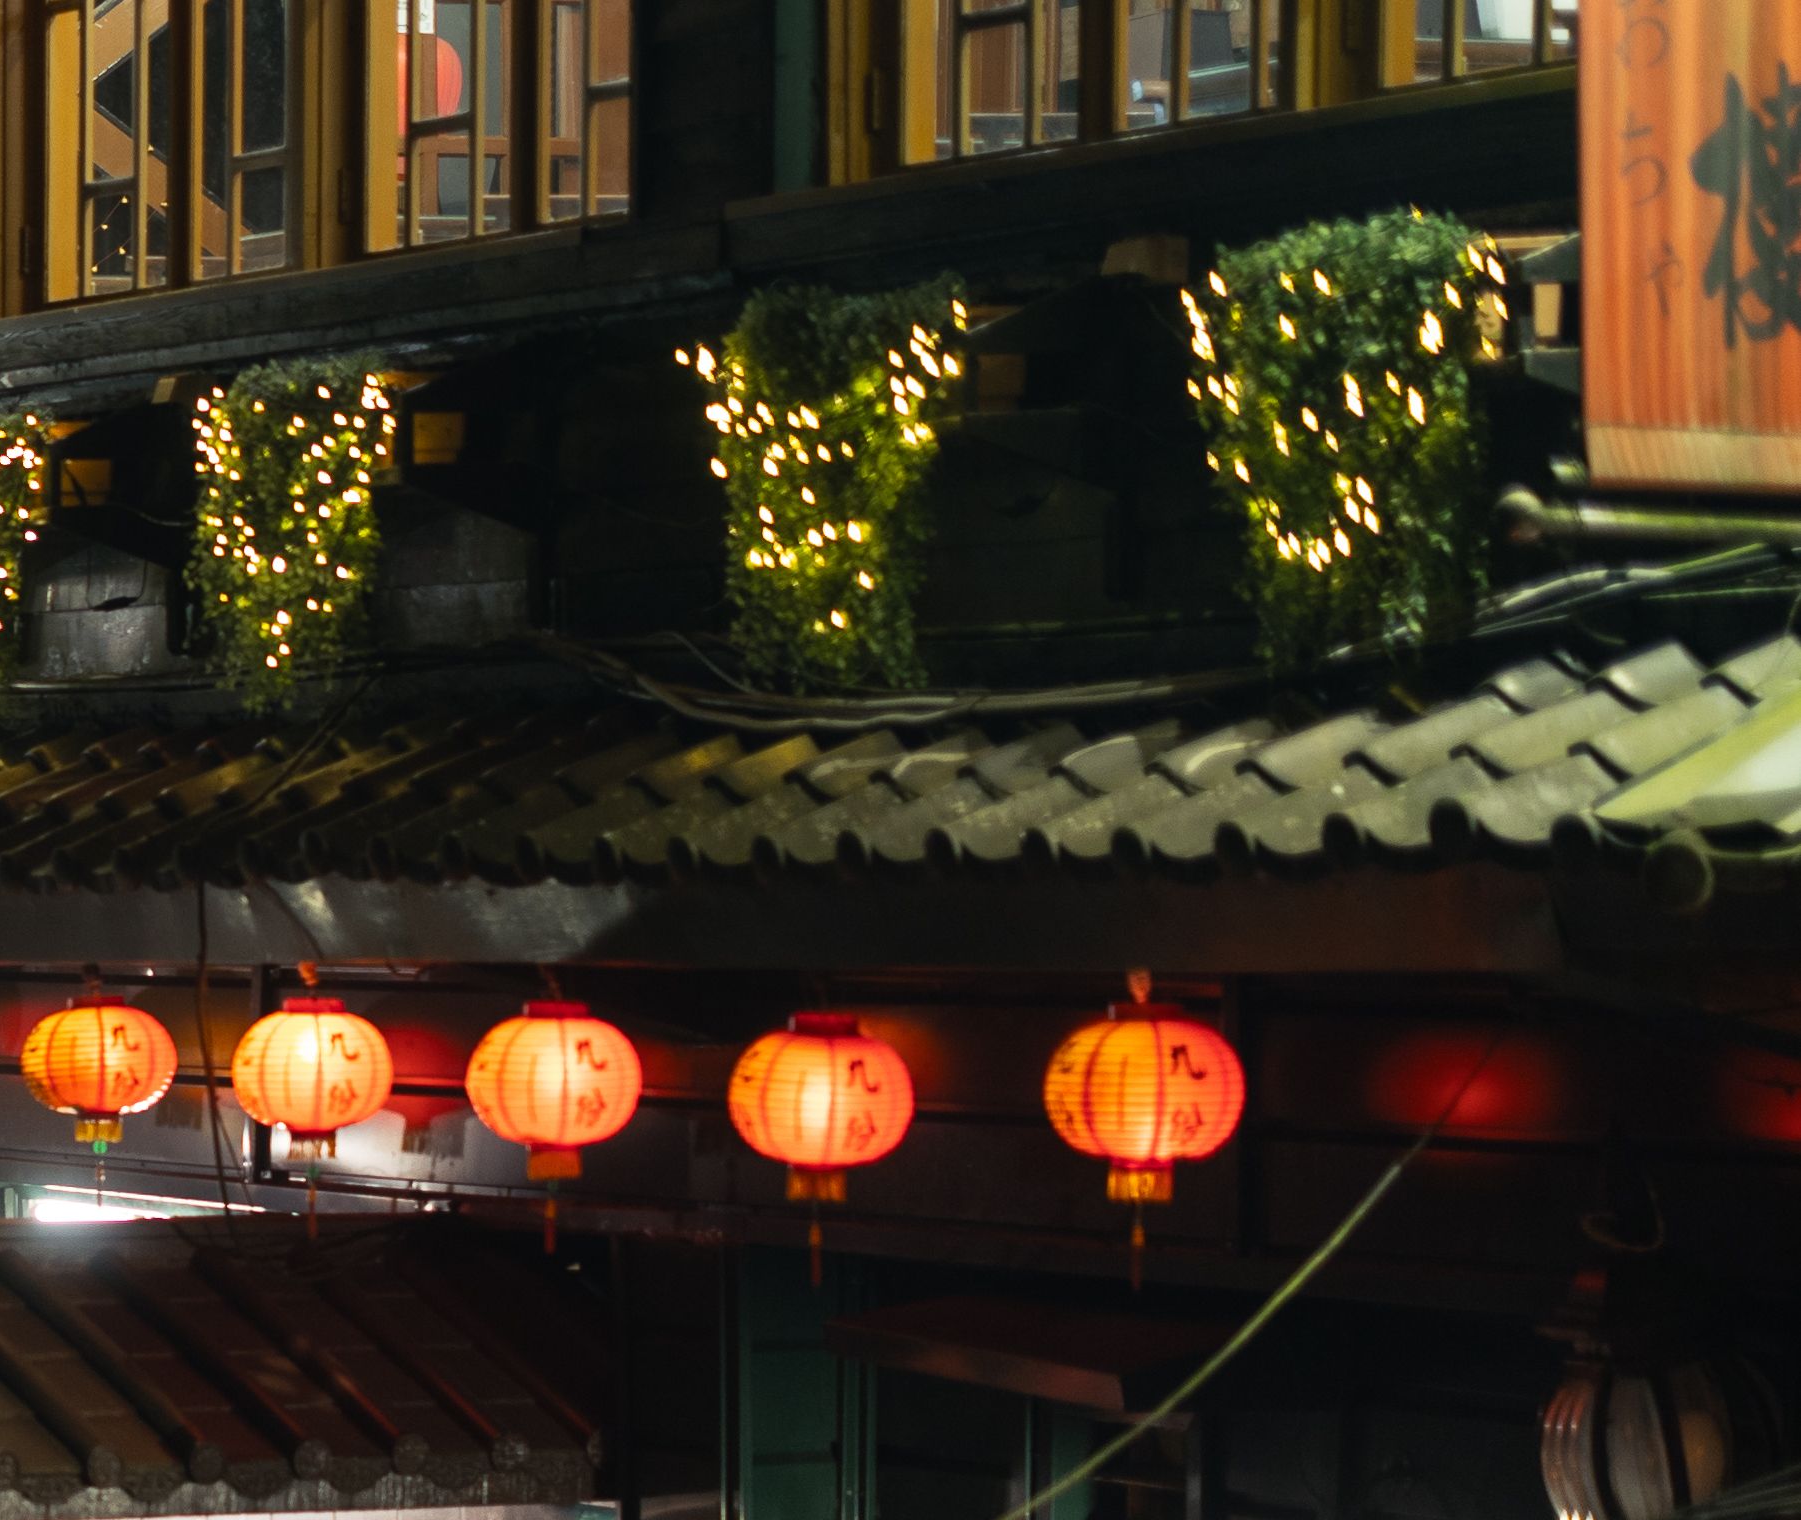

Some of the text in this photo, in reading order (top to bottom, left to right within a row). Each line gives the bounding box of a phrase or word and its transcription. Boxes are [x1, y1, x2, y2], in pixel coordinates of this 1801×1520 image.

[112, 1025, 140, 1097] 九份
[328, 1032, 359, 1113] 九份
[575, 1037, 607, 1127] 九份
[847, 1059, 879, 1150] 九份
[1170, 1044, 1206, 1145] 九份
